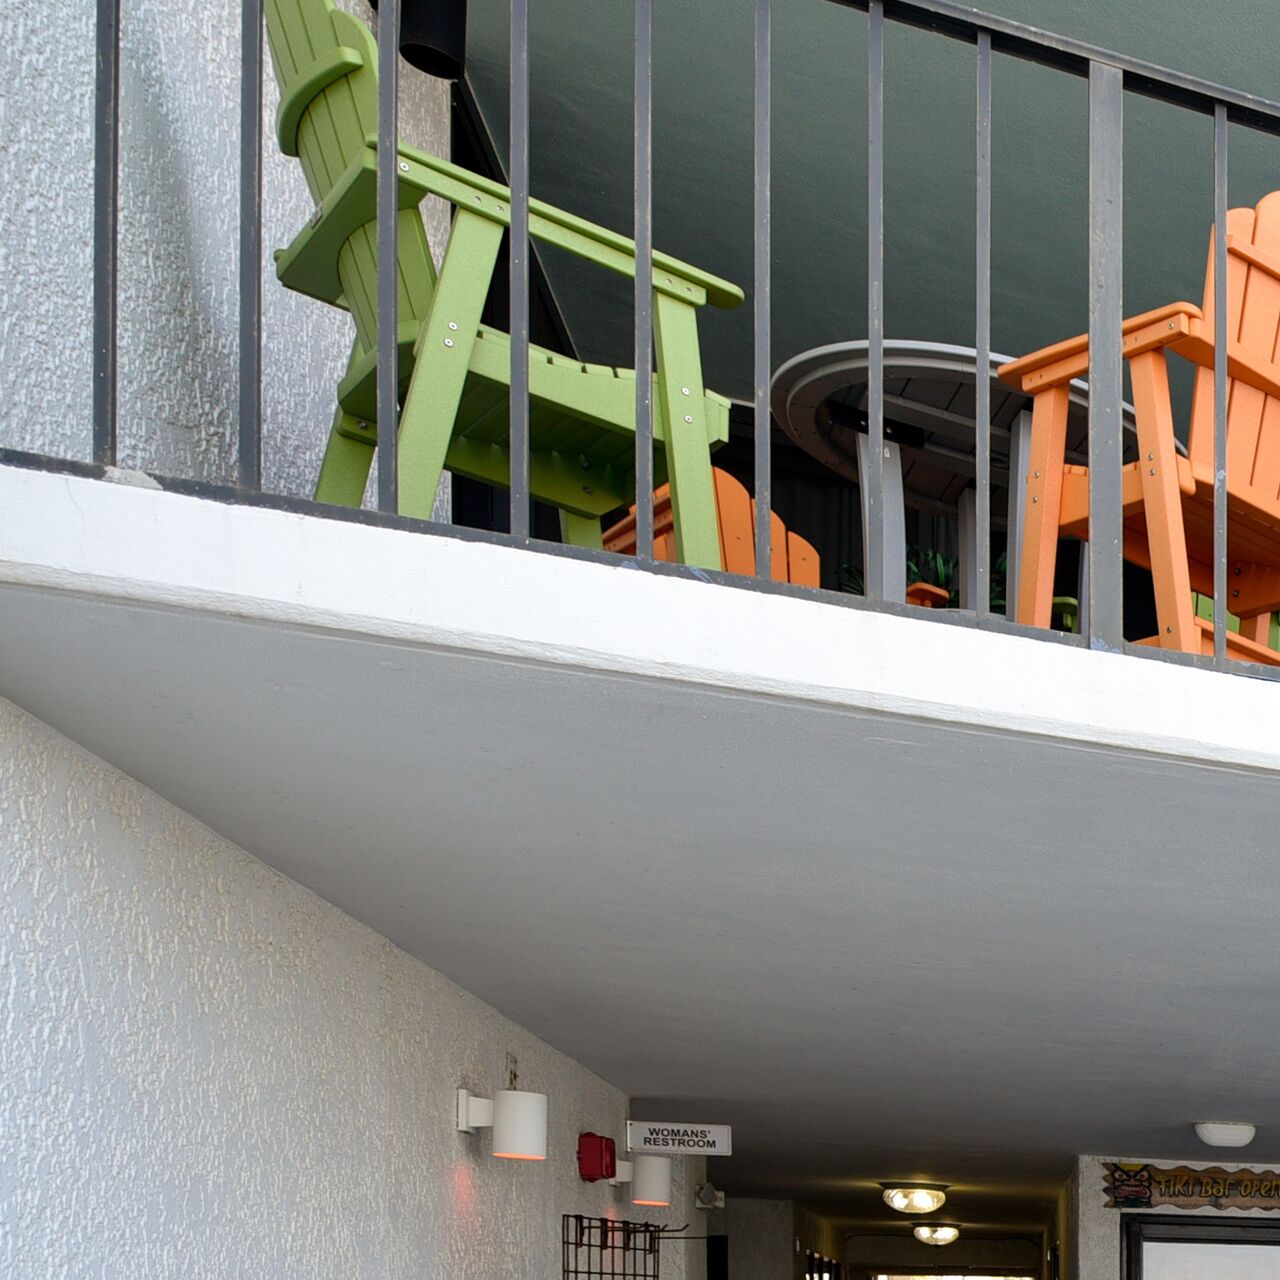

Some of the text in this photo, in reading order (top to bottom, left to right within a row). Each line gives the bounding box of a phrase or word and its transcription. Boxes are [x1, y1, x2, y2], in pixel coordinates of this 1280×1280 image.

[647, 1127, 711, 1139] WOMANS'
[643, 1136, 717, 1149] RESTROOM
[1158, 1175, 1194, 1197] TIKI
